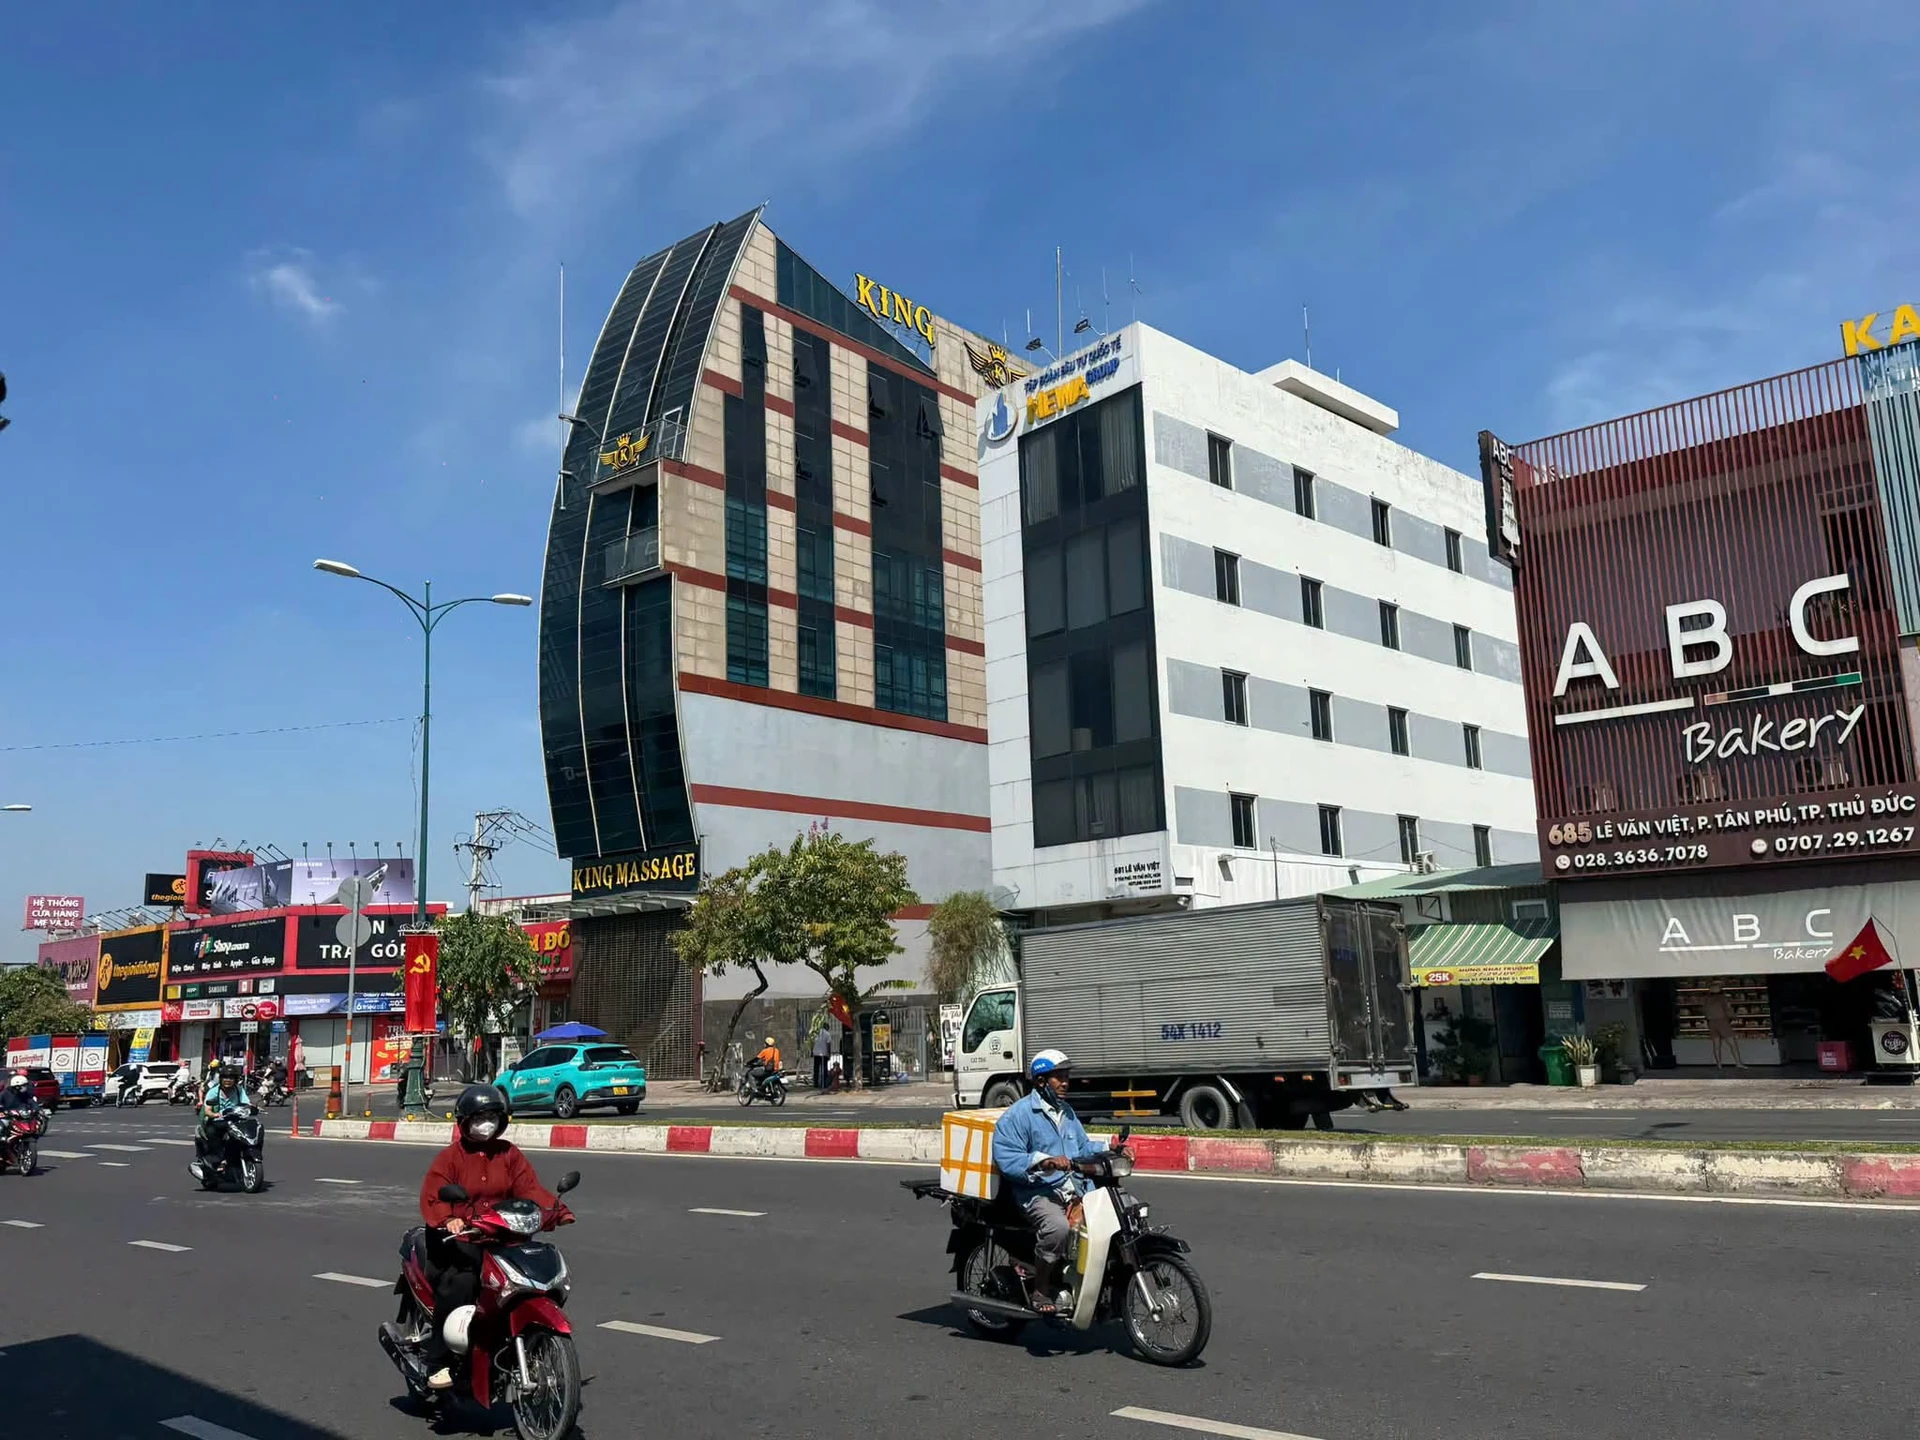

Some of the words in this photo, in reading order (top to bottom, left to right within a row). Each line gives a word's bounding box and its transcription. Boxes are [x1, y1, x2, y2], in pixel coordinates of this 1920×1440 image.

[855, 272, 935, 347] KING
[1027, 375, 1091, 424] NEWA
[1085, 357, 1120, 386] GROUP
[1682, 704, 1864, 763] Bakery
[1549, 821, 1593, 846] 685
[1596, 820, 1613, 839] LÊ
[1617, 818, 1651, 838] VĂN
[1655, 814, 1695, 837] VIỆT,
[1698, 815, 1713, 831] P.
[1714, 808, 1750, 829] TÂN
[1754, 802, 1797, 825] PHÚ,
[1798, 804, 1825, 821] TP.
[1828, 793, 1865, 818] THỦ
[1871, 790, 1916, 814] ĐỨC
[1775, 826, 1915, 852] 0707.29.1267
[1574, 844, 1709, 868] 028.3636.7078
[573, 864, 613, 893] KING
[616, 853, 696, 888] MASSAGE
[47, 896, 79, 907] THỐNG
[53, 908, 79, 918] HÀNG
[1773, 946, 1833, 960] Bakery
[1428, 973, 1450, 982] 25K
[1192, 1021, 1222, 1039] 1412
